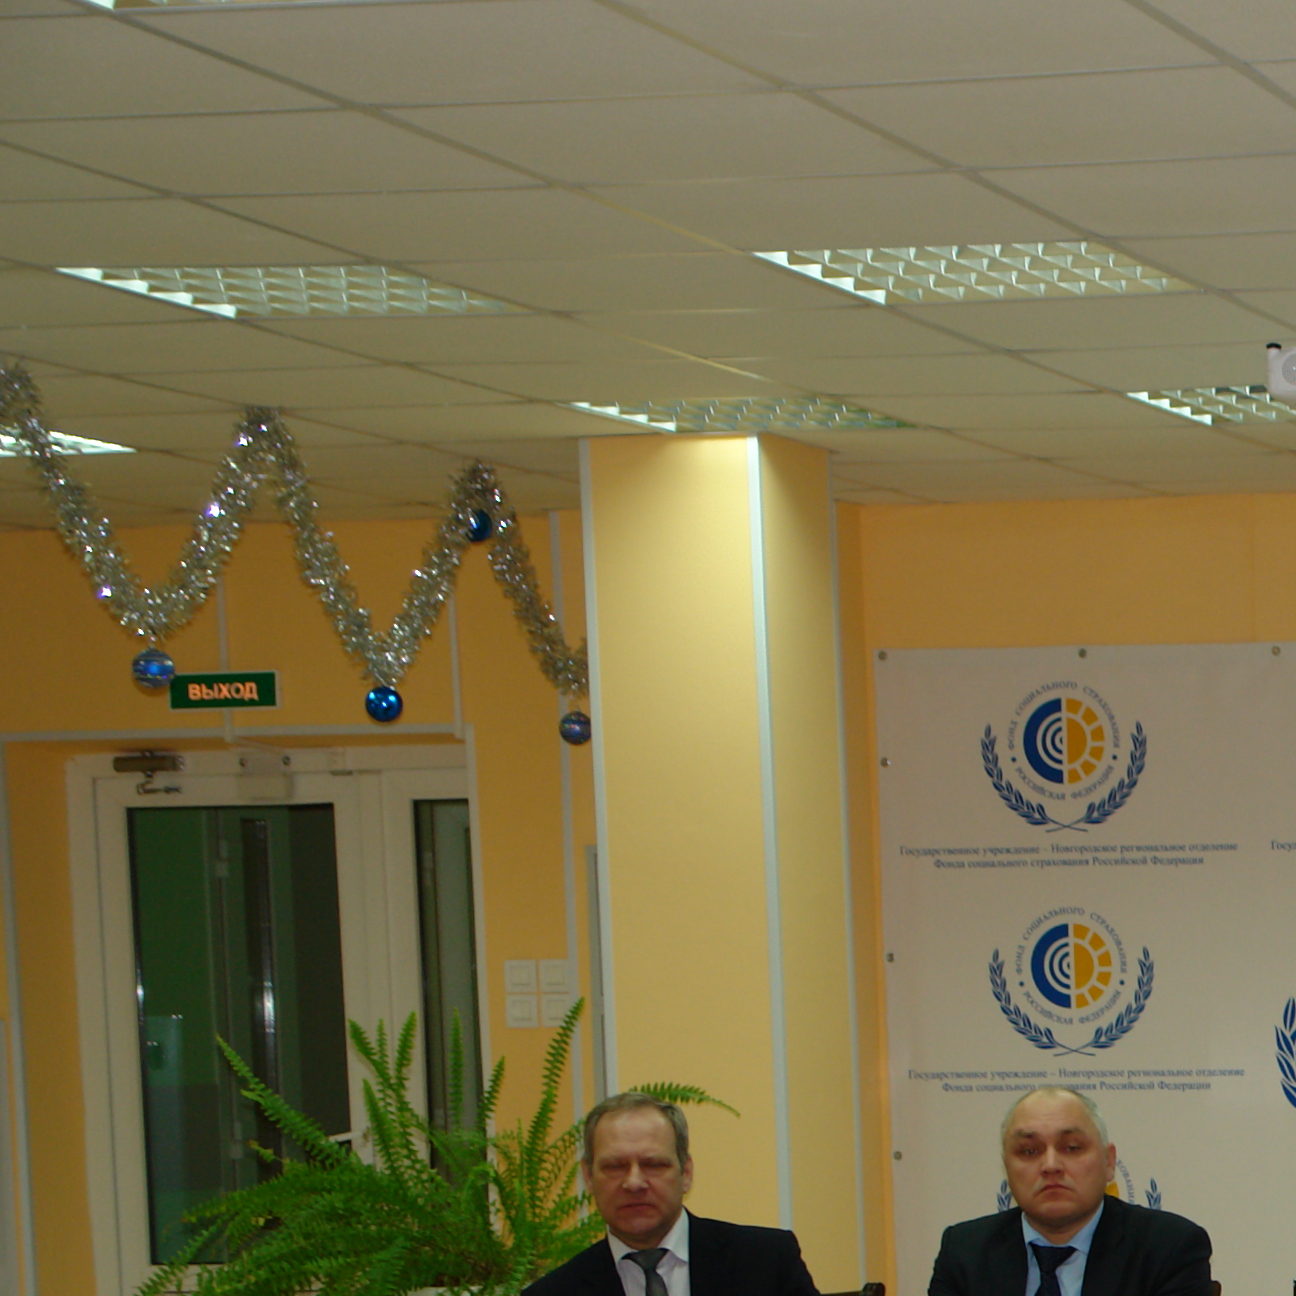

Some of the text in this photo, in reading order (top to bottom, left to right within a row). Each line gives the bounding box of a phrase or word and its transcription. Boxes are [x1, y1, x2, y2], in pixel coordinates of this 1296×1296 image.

[188, 682, 258, 700] ВЫХОД
[900, 842, 1237, 856] Государственное учреждение Новгородское региональное отделение
[934, 855, 1204, 868] Фонда социального страхования Российской Федерации
[908, 1067, 1245, 1080] Государственное учреждение Новгородское региональное отделение
